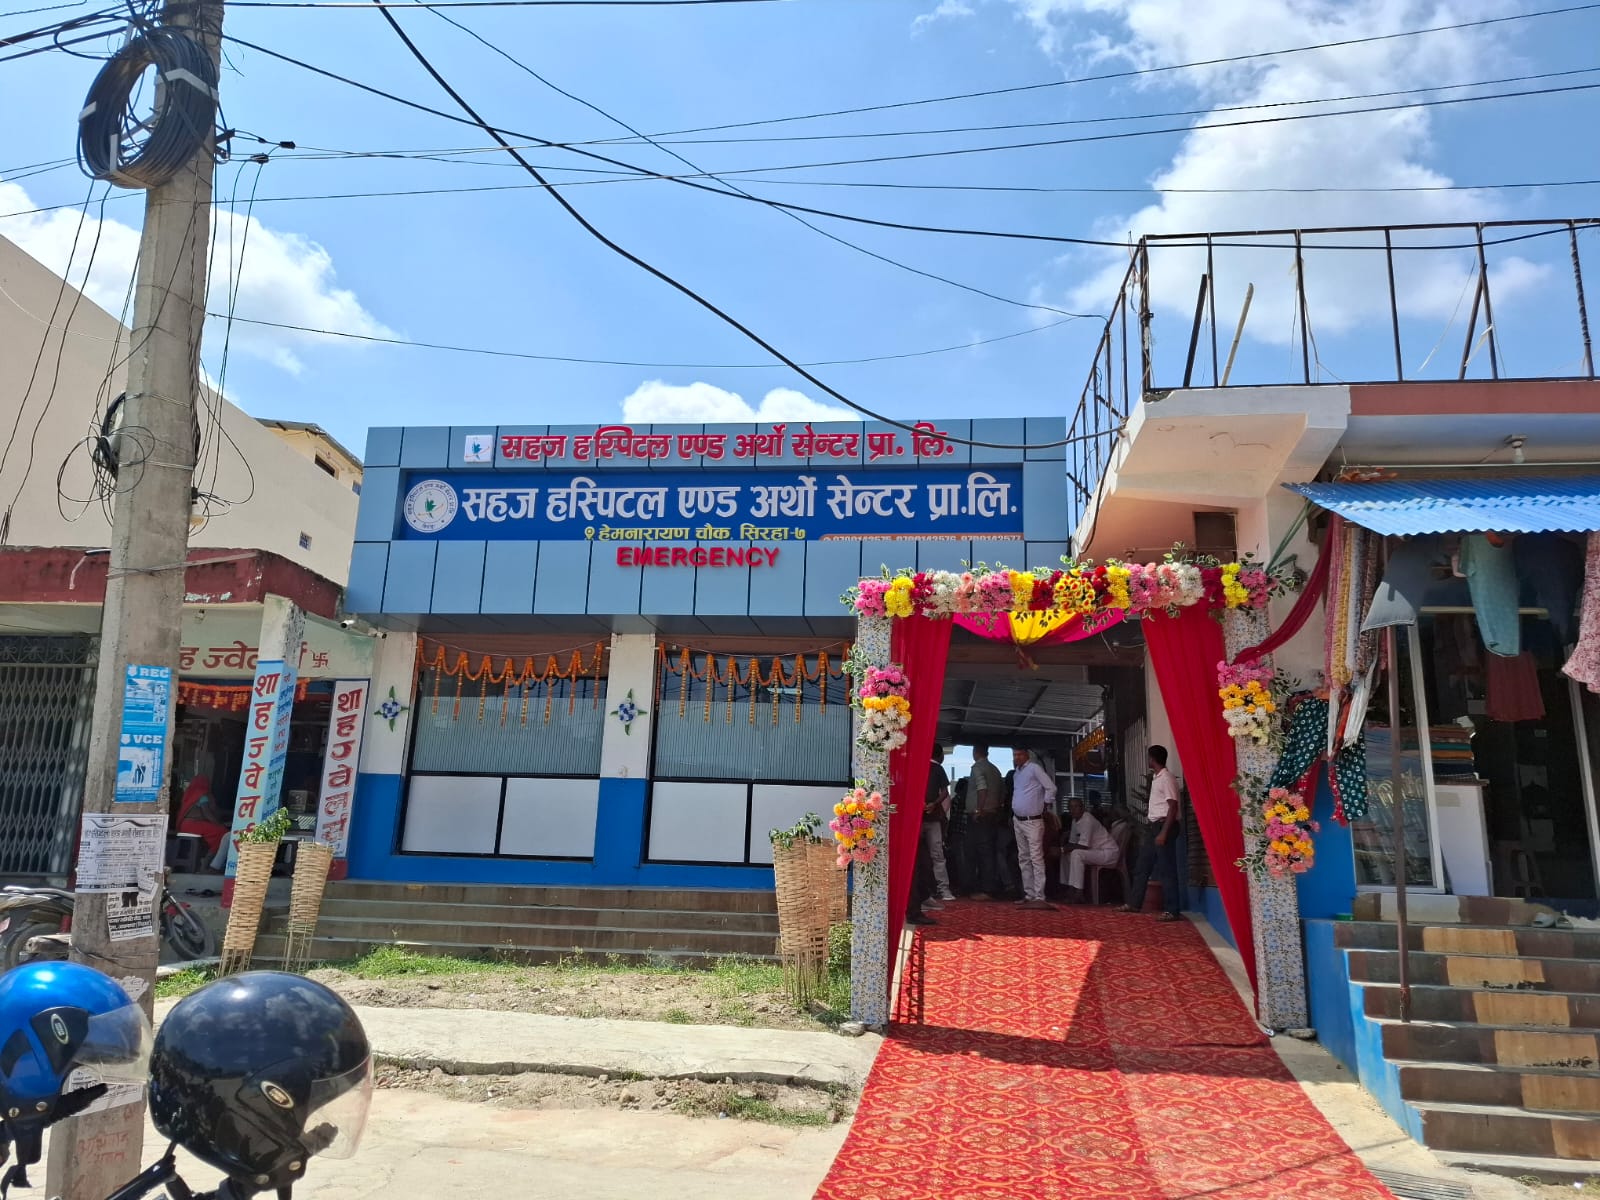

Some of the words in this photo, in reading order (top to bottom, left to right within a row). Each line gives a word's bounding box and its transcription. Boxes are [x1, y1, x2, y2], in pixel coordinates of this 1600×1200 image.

[501, 434, 568, 461] सहज
[573, 425, 673, 460] हस्पिटल
[677, 433, 727, 460] एण्ड
[732, 423, 786, 458] अर्थो
[791, 424, 859, 458] सेन्टर
[461, 488, 539, 522] सहज
[545, 476, 669, 522] हस्पिटल
[677, 486, 741, 519] एण्ड
[750, 475, 817, 518] अर्थो
[827, 475, 917, 520] सेन्टर
[598, 523, 690, 541] हेमनारायण
[616, 547, 781, 567] EMERGENCY
[140, 667, 169, 678] REC
[133, 734, 162, 744] VCE
